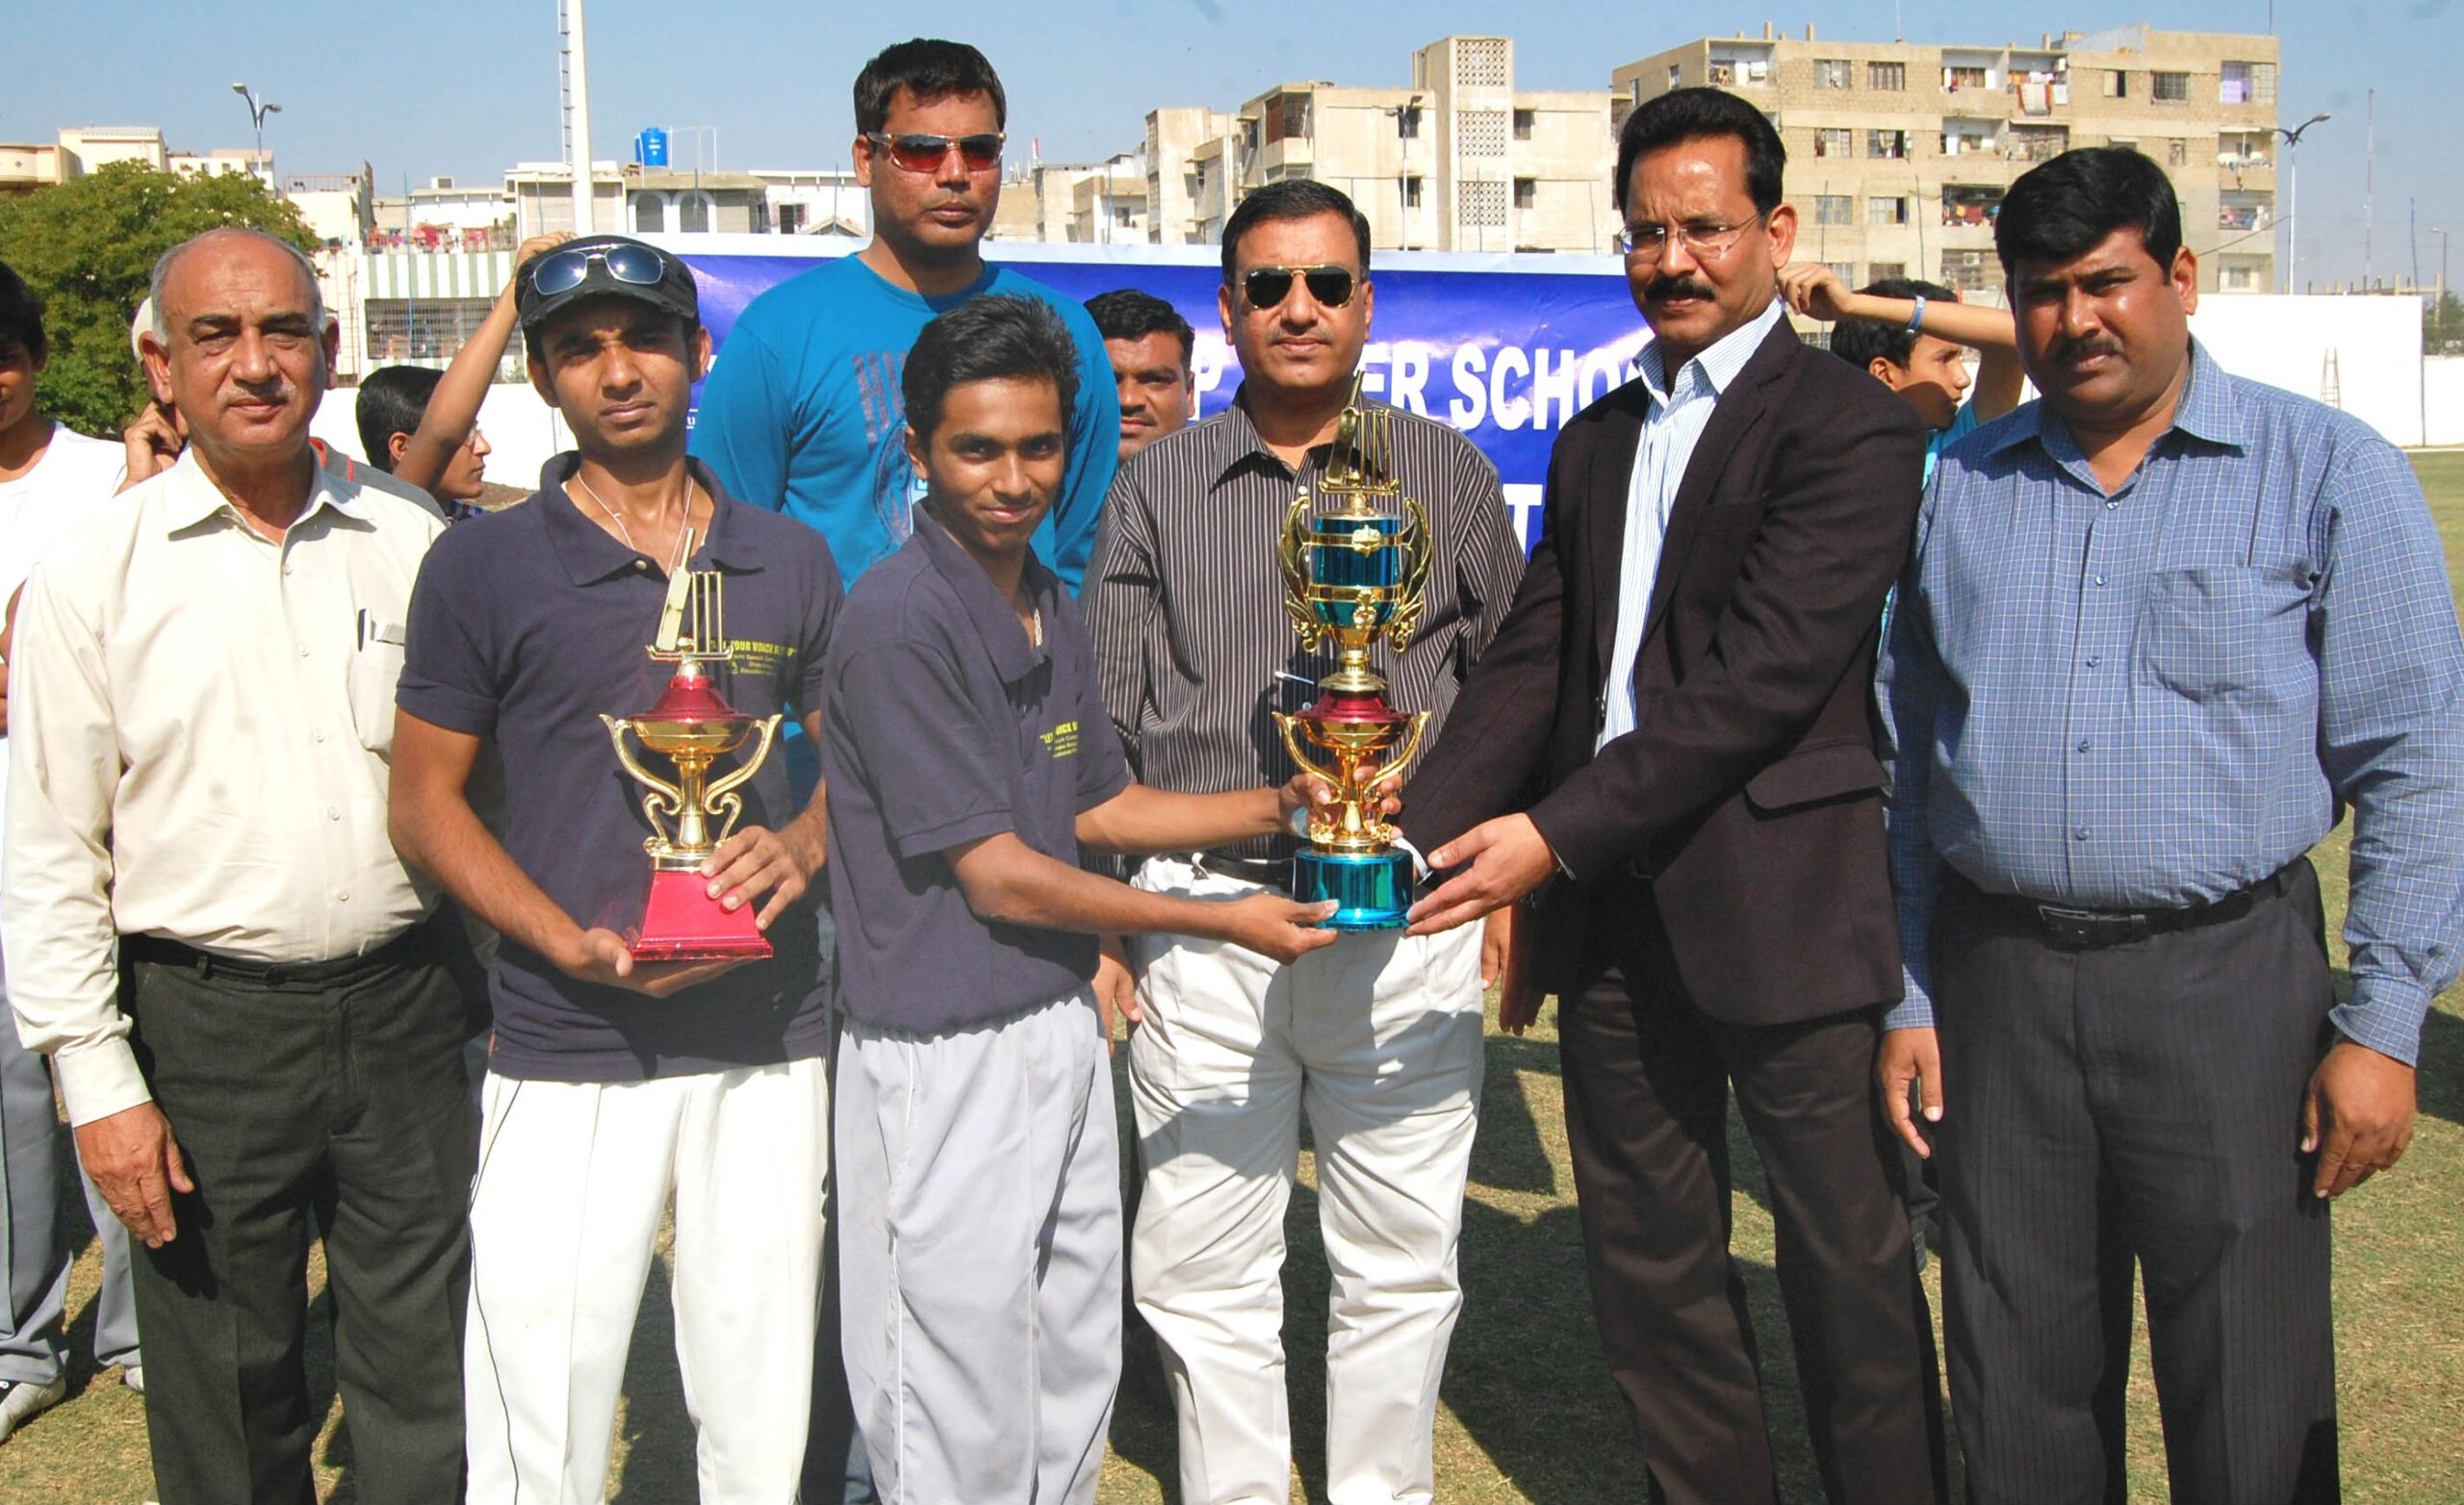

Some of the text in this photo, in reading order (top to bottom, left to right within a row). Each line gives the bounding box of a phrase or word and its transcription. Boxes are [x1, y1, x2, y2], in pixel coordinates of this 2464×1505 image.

[1353, 341, 1429, 418] ER
[1450, 343, 1640, 430] SCHO
[731, 640, 751, 651] OUR
